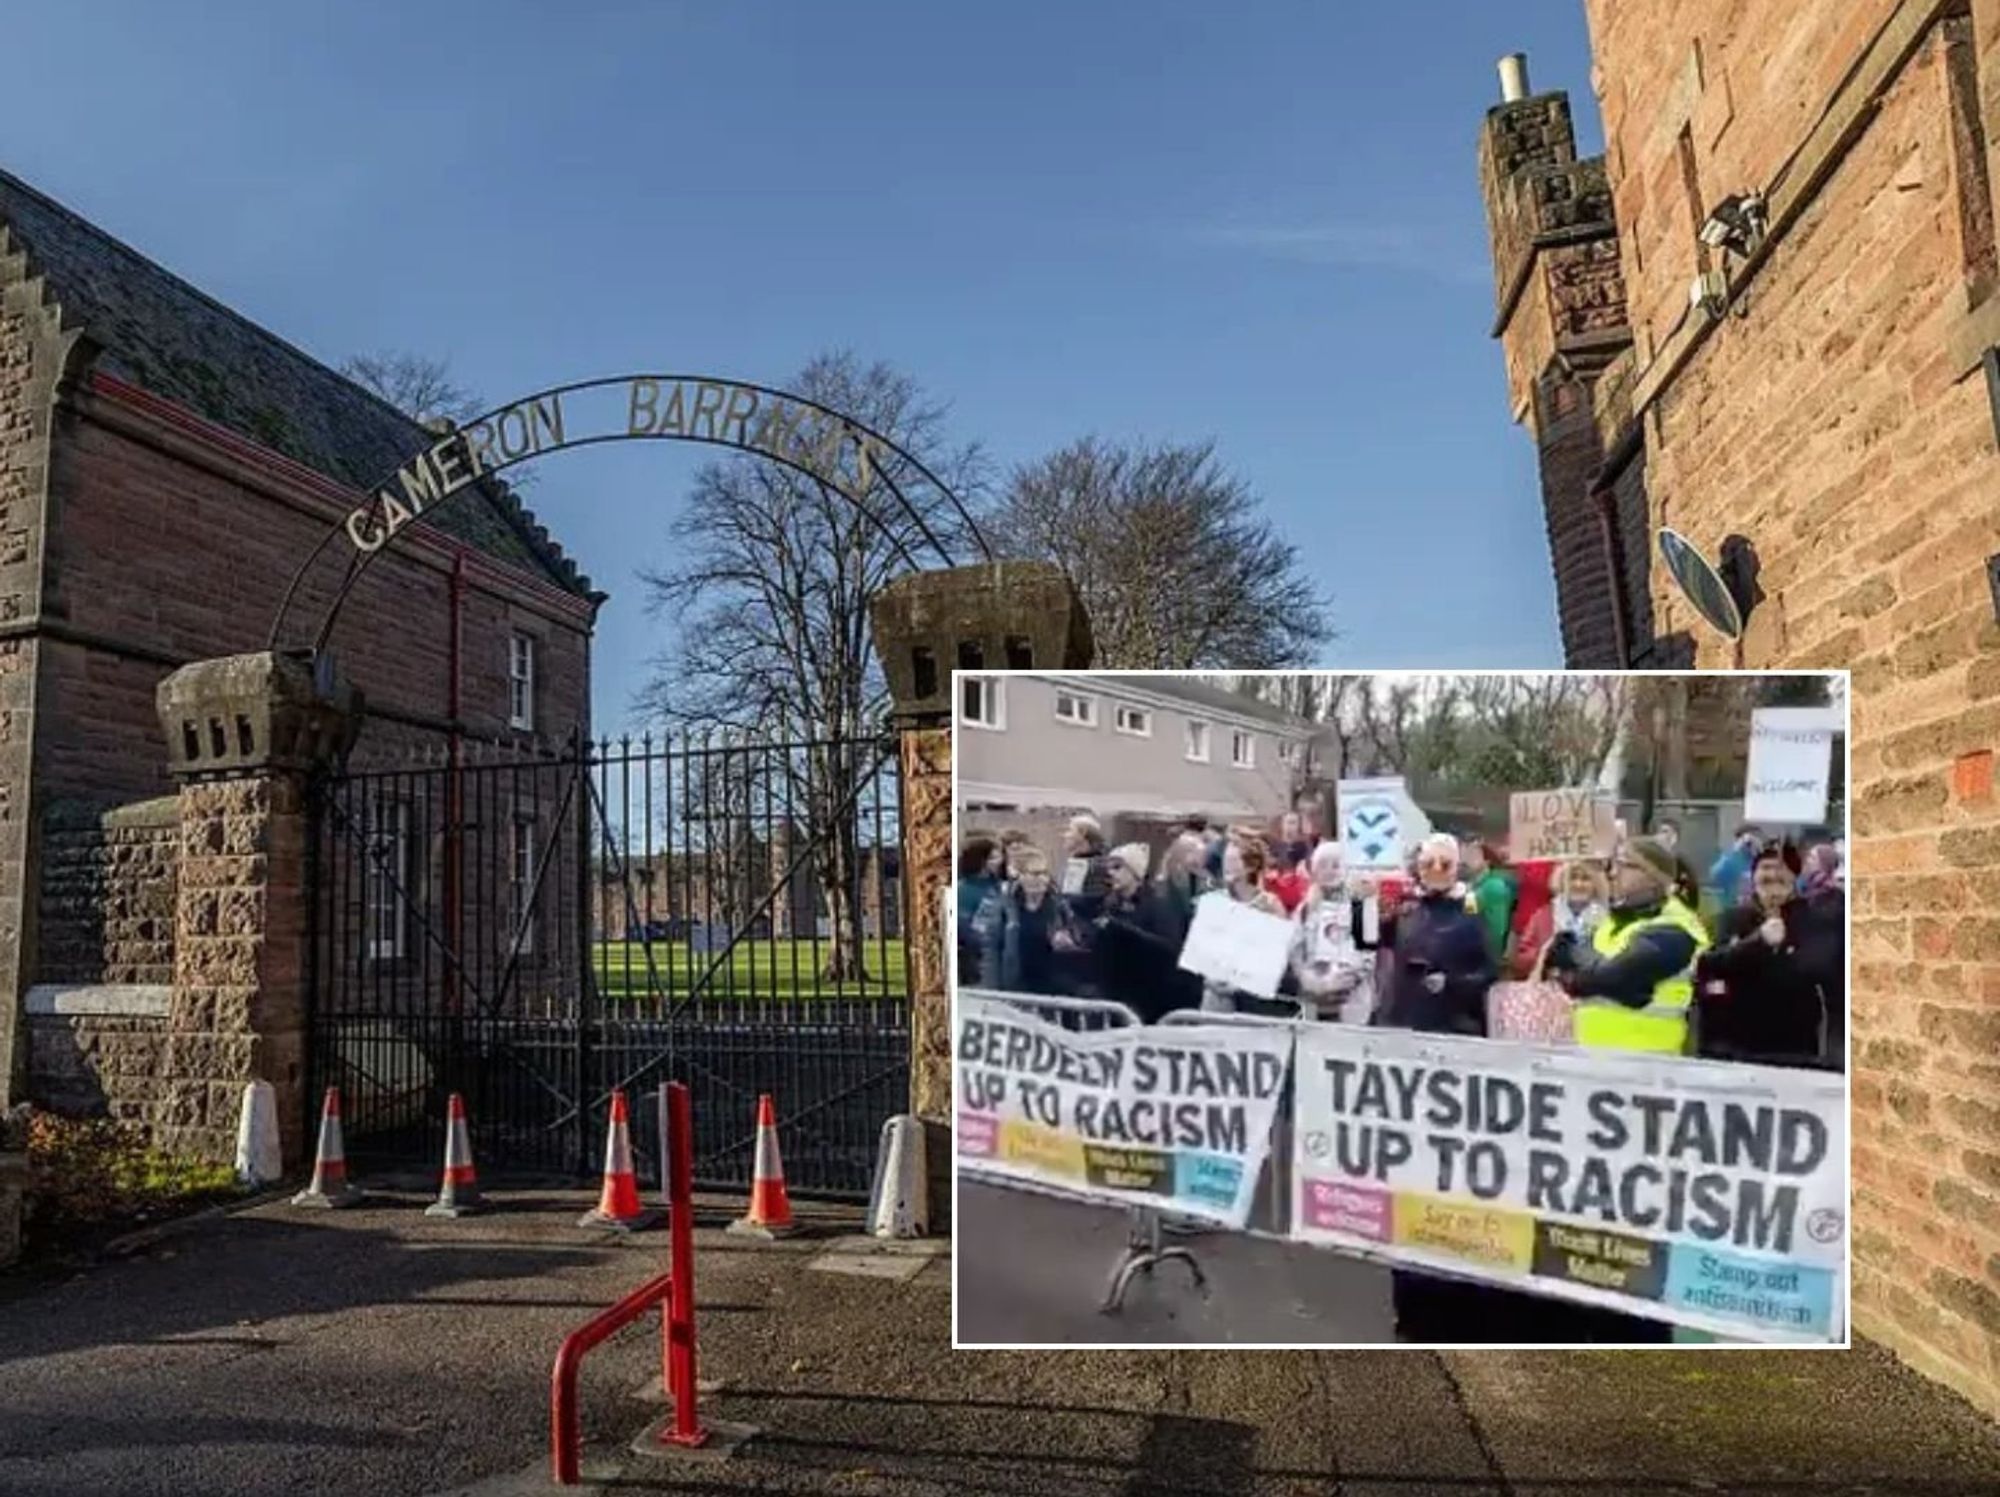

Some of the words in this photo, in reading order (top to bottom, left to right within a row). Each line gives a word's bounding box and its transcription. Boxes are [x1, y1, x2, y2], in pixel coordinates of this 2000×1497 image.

[346, 393, 565, 551] CAMERON
[962, 1070, 1005, 1111] UP
[1018, 1080, 1061, 1127] TO
[1074, 1096, 1247, 1154] RACISM
[1132, 1047, 1282, 1098] STAND
[1324, 1058, 1568, 1143] TAYSIDE
[1587, 1091, 1828, 1175] STAND
[1336, 1122, 1412, 1179] UP
[1428, 1135, 1508, 1198] TO
[1527, 1151, 1801, 1254] RACISM
